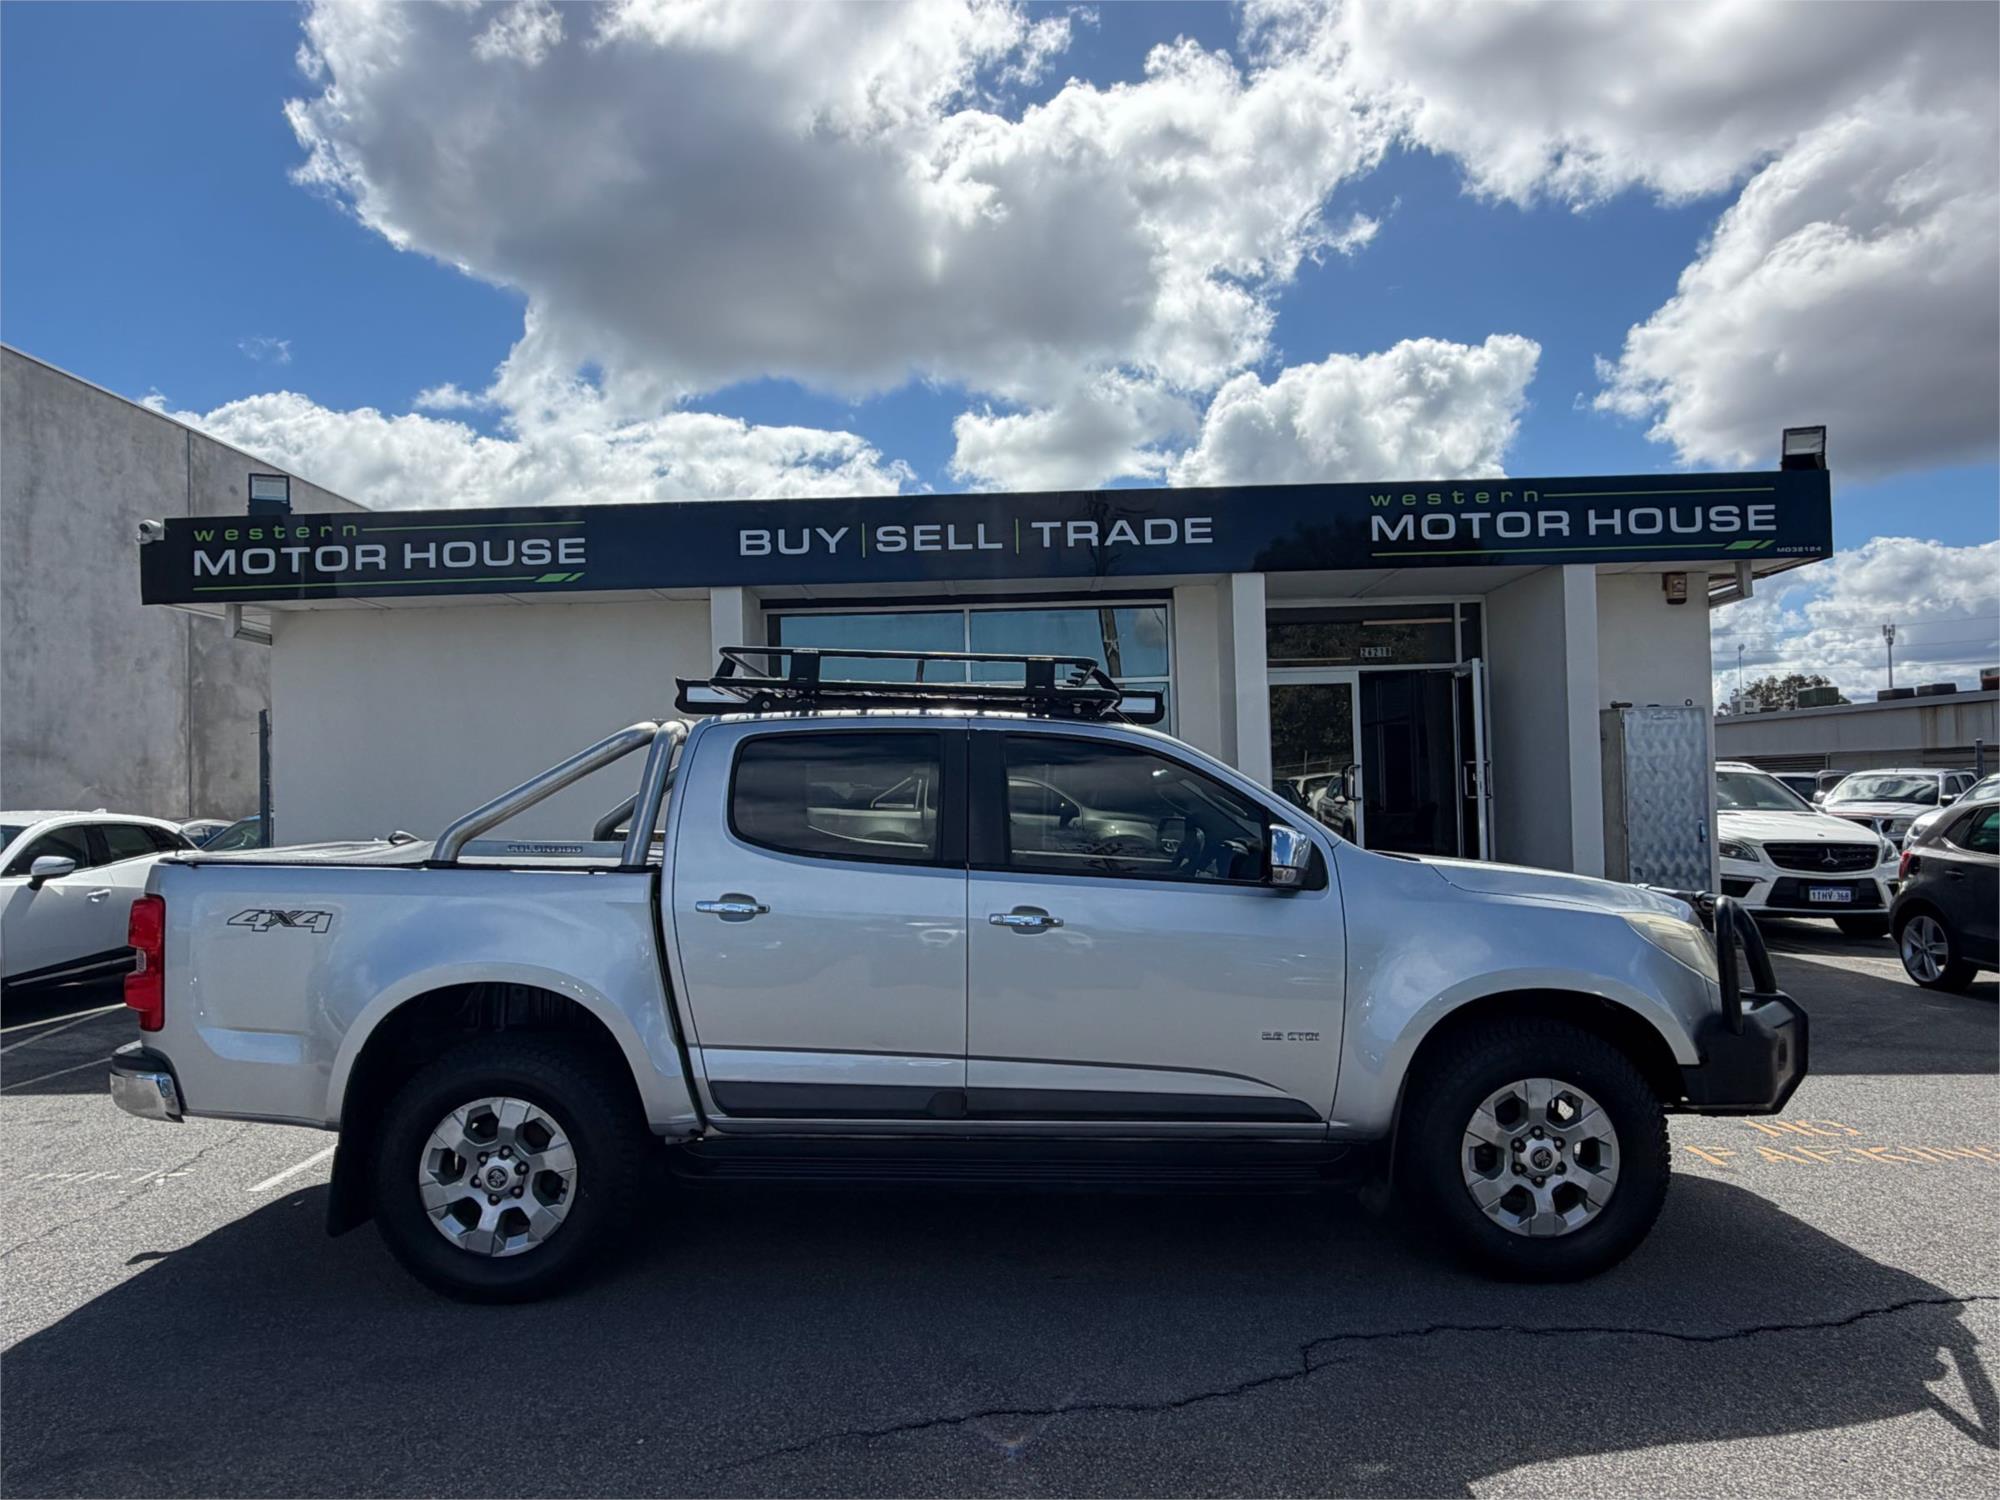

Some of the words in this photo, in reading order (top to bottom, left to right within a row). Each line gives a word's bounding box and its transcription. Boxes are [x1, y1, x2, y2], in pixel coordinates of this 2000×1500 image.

[1370, 489, 1539, 507] western
[193, 524, 358, 542] western
[739, 526, 849, 556] BUY
[875, 523, 1004, 553] SELL
[1030, 517, 1214, 548] TRADE
[1371, 510, 1571, 542] MOTOR
[1587, 504, 1777, 536] HOUSE
[193, 544, 387, 577] MOTOR
[403, 537, 587, 570] HOUSE
